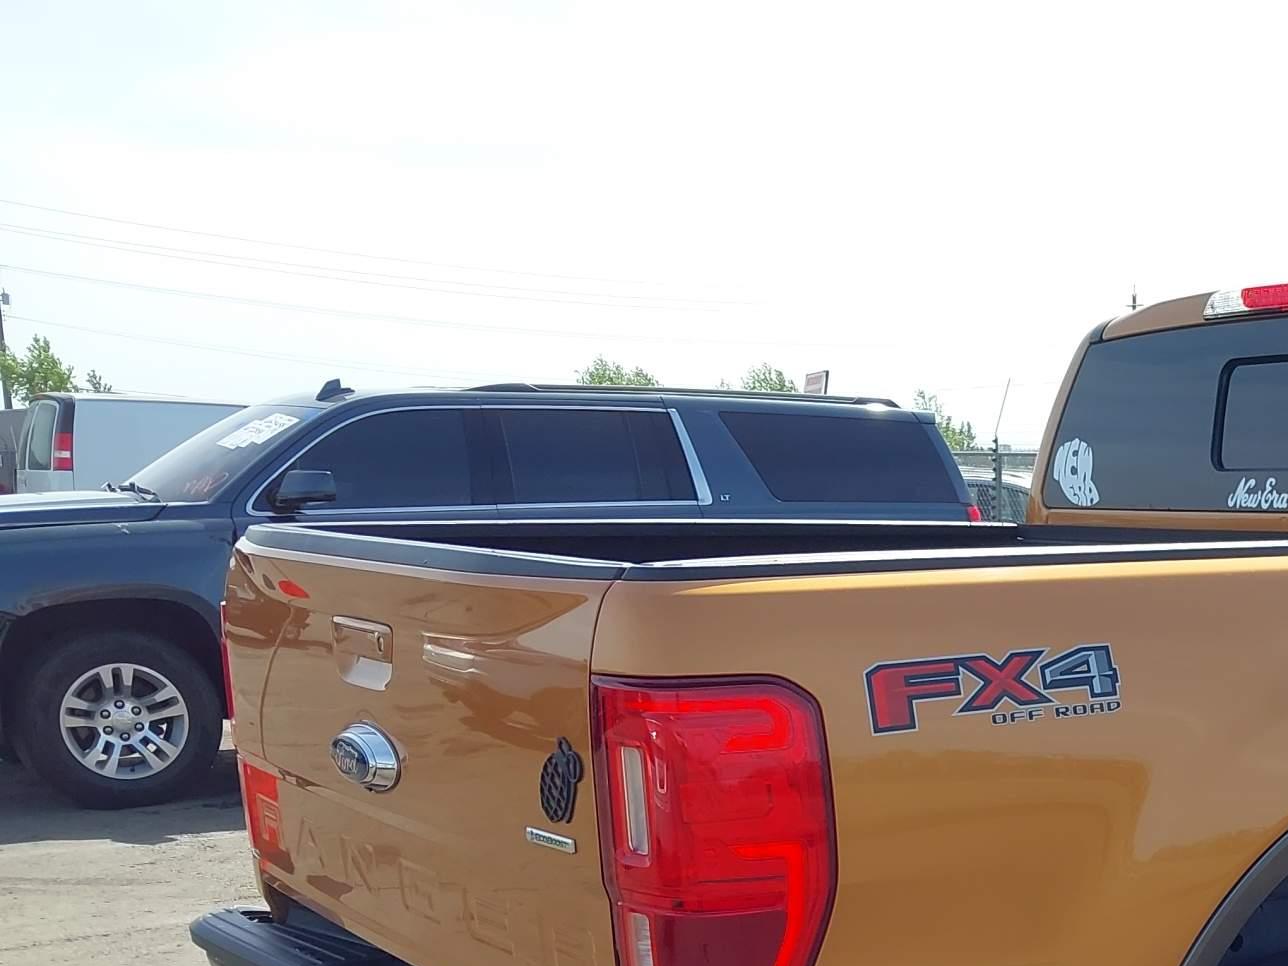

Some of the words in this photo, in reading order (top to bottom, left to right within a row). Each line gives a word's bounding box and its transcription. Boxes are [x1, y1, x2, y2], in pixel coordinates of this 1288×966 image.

[1228, 477, 1261, 509] New
[1261, 477, 1288, 509] Era
[864, 643, 1120, 735] FX4
[991, 708, 1045, 726] OFF
[1055, 700, 1121, 719] ROAD
